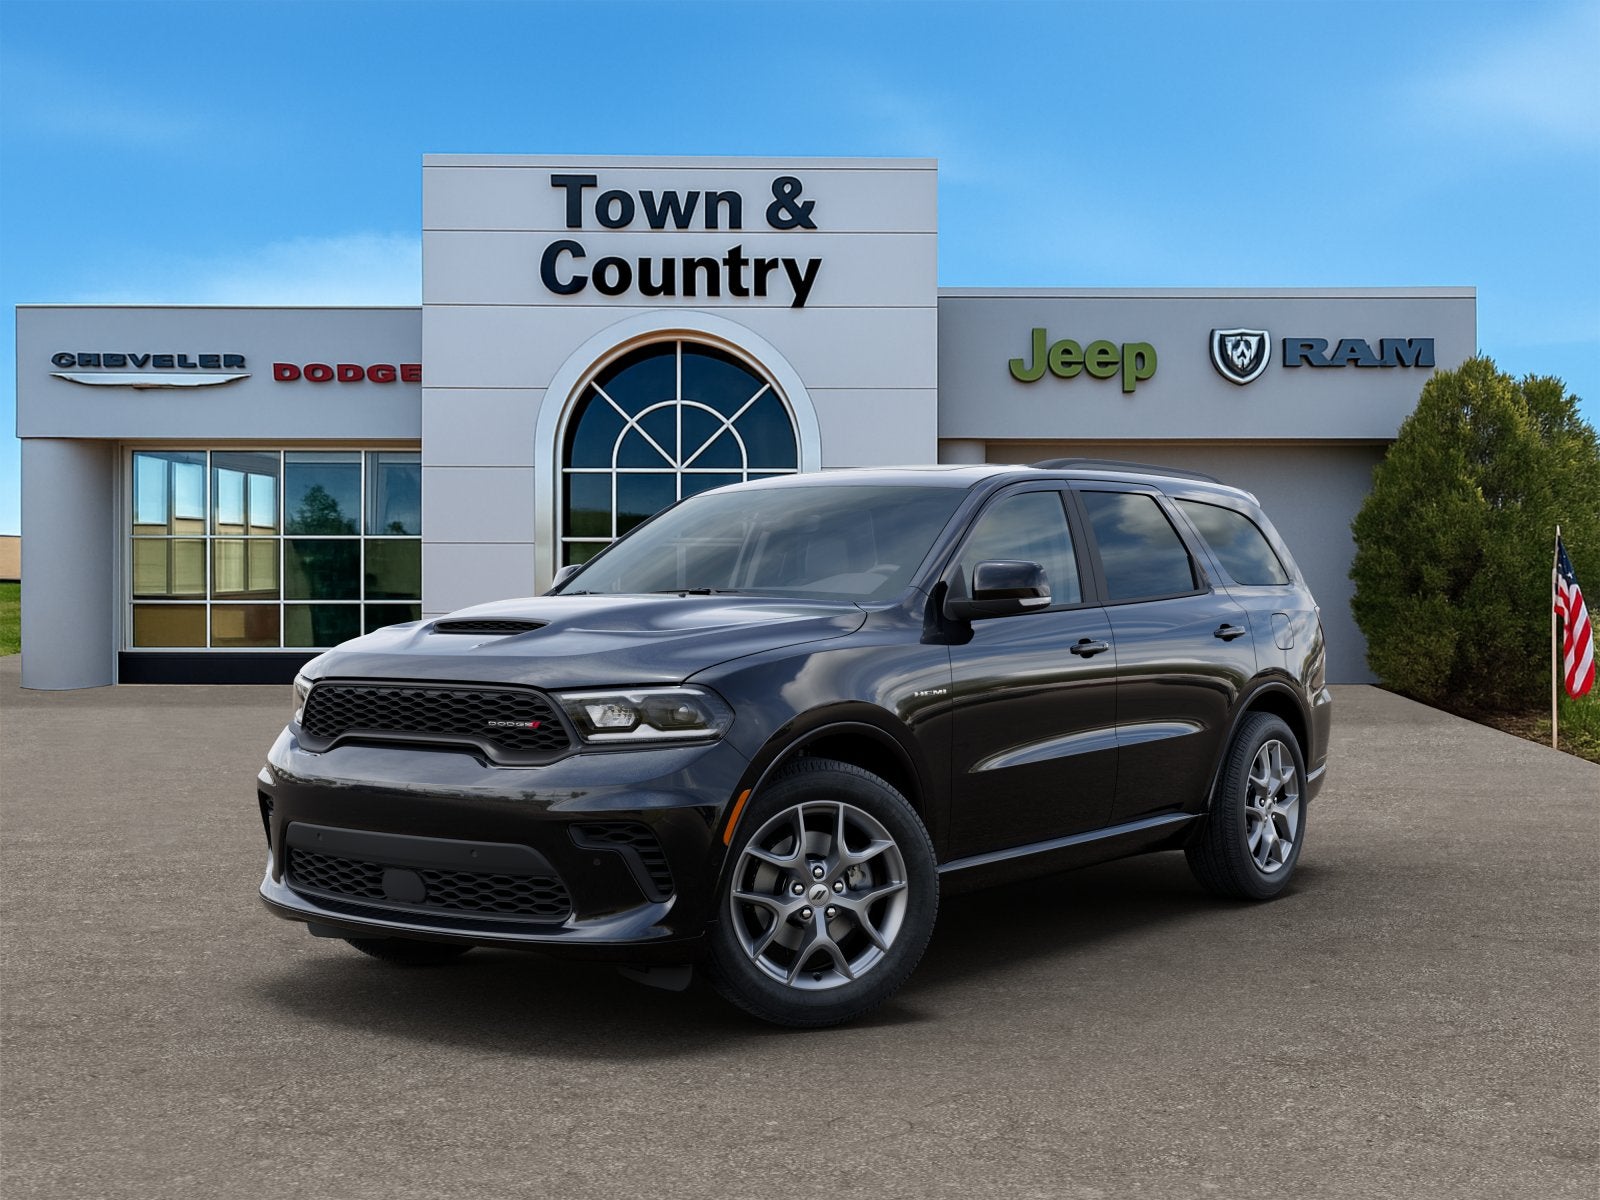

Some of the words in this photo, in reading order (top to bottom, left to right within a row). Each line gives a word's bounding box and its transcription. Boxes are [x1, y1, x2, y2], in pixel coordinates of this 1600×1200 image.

[550, 174, 743, 229] Town
[765, 175, 818, 230] &
[540, 239, 822, 308] Country
[273, 363, 422, 383] DODGE
[1009, 328, 1157, 393] Jeep
[1282, 337, 1435, 368] RAM
